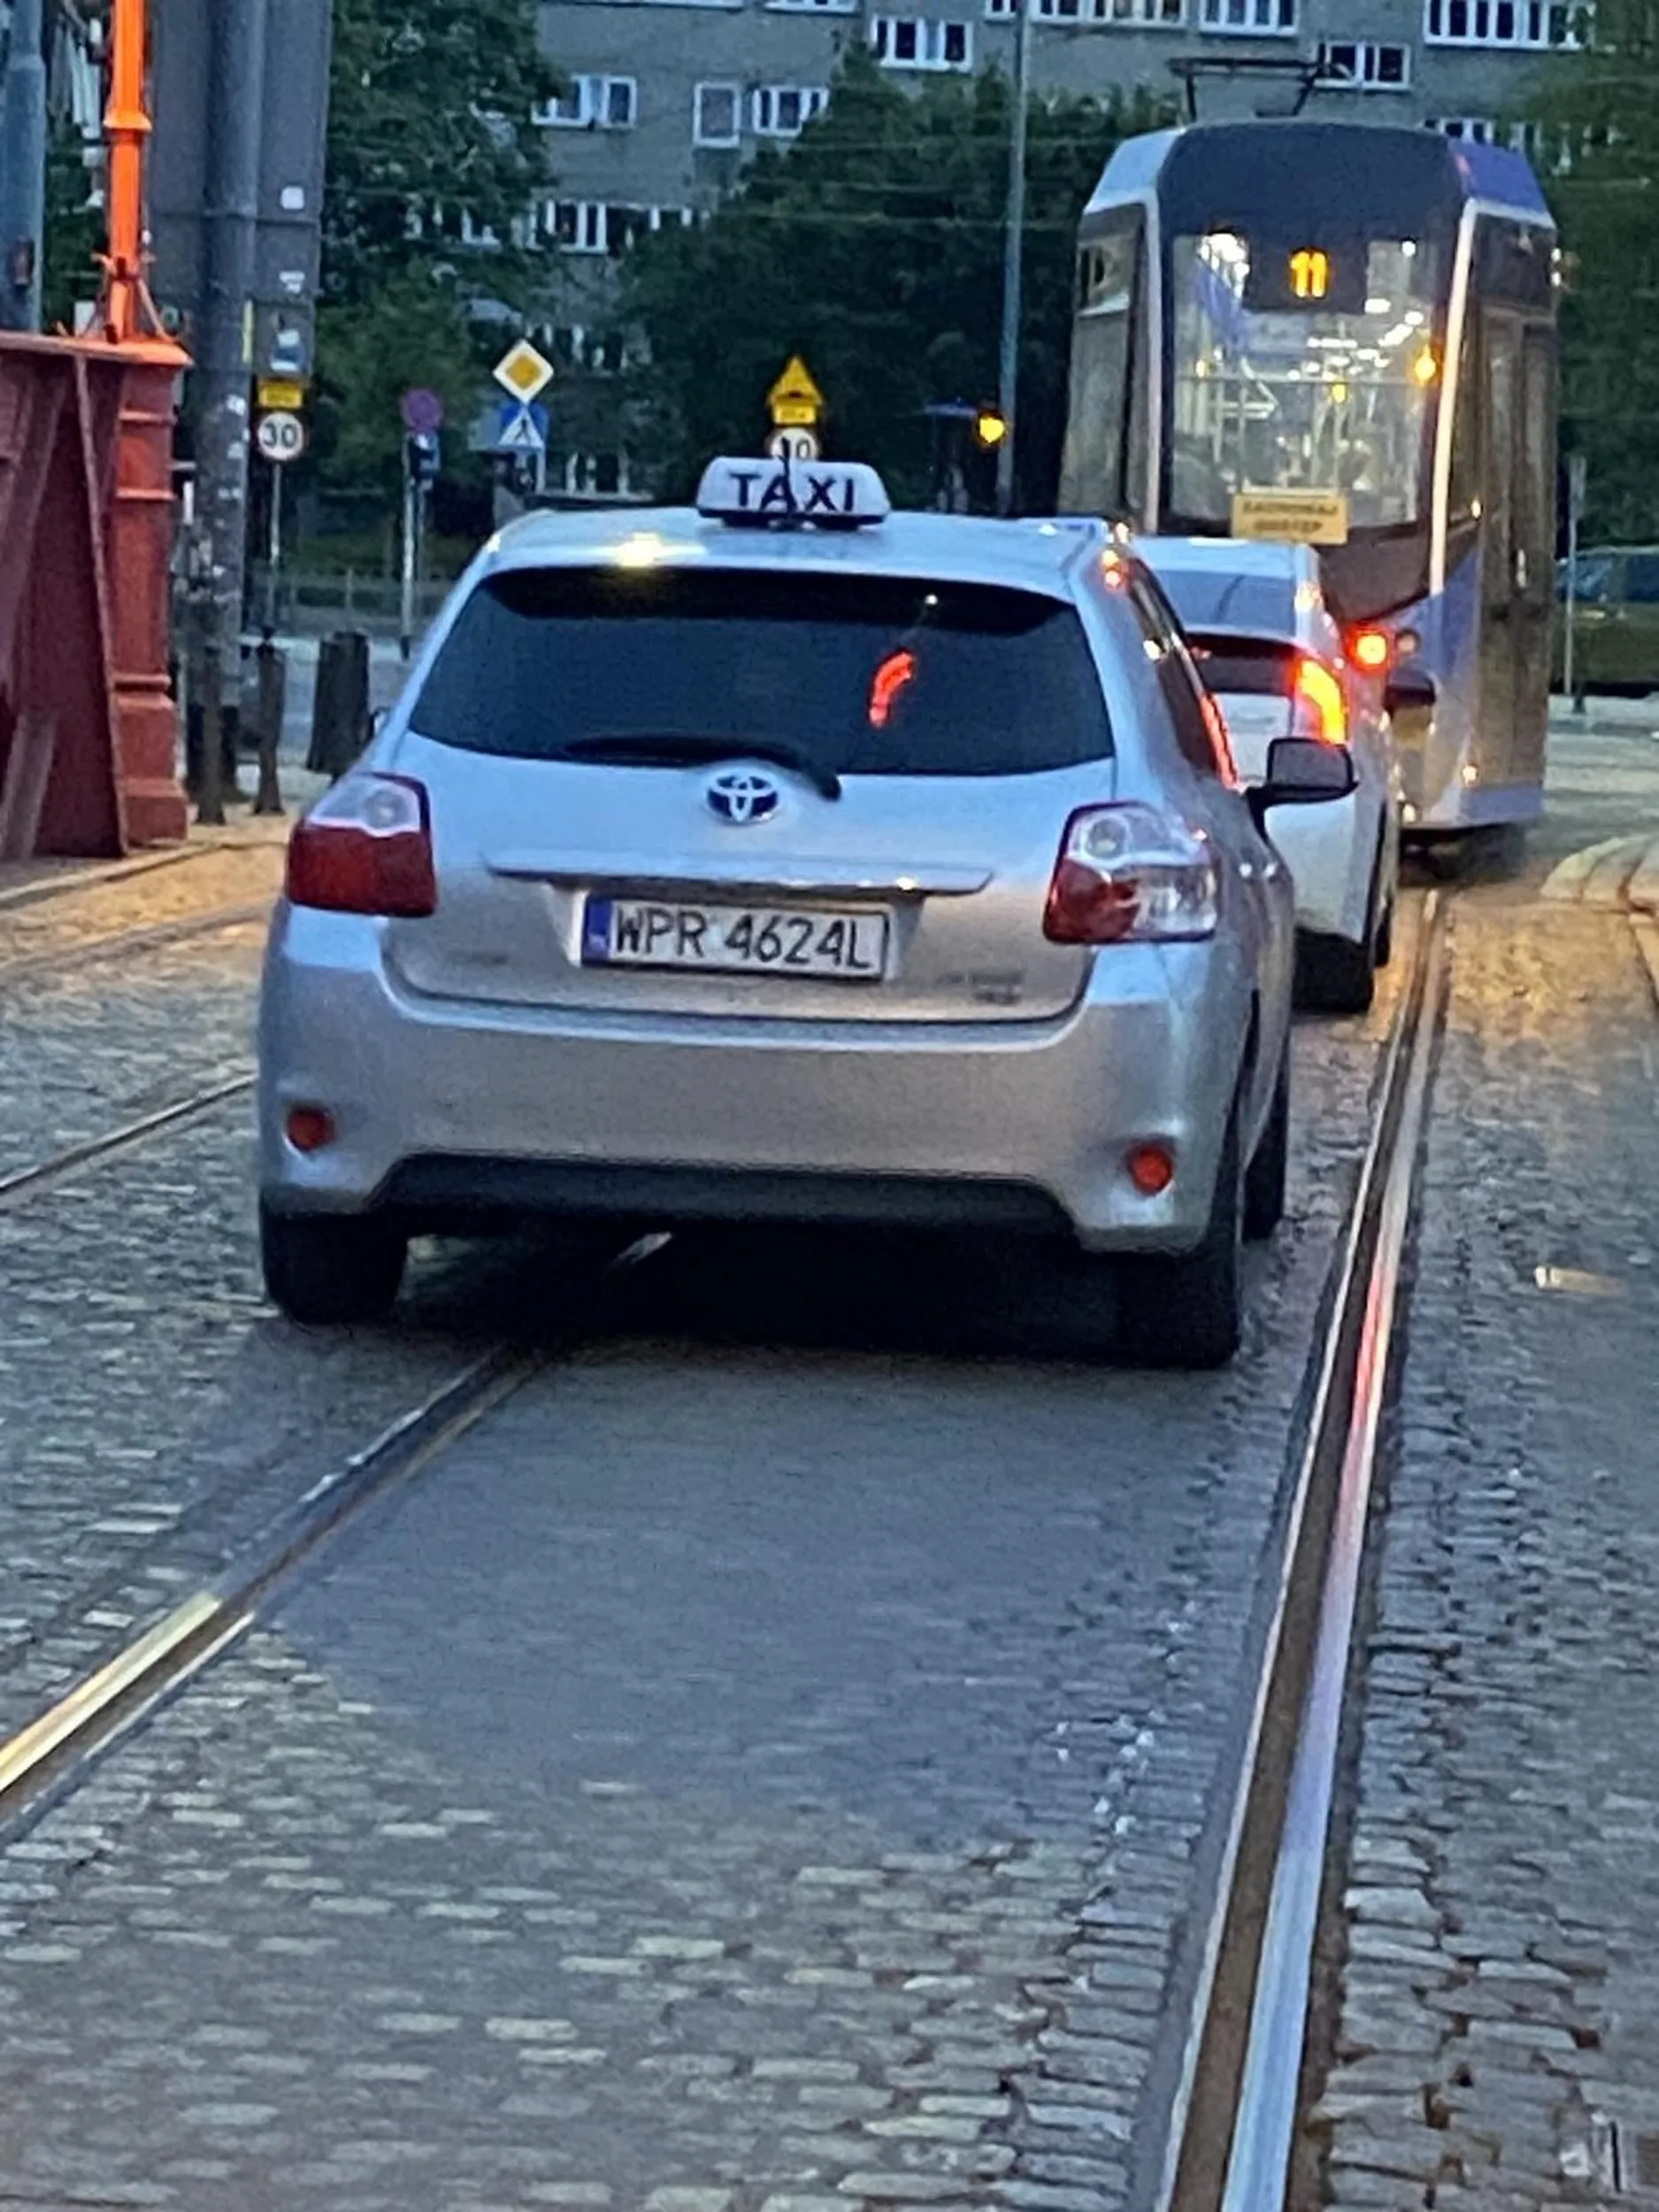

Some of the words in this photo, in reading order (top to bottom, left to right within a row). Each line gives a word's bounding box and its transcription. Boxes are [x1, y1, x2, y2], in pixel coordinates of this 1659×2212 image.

[1290, 251, 1326, 298] 11
[264, 422, 298, 449] 30
[729, 472, 856, 512] TAXI
[617, 907, 708, 957] WPR
[725, 913, 872, 969] 4624L
